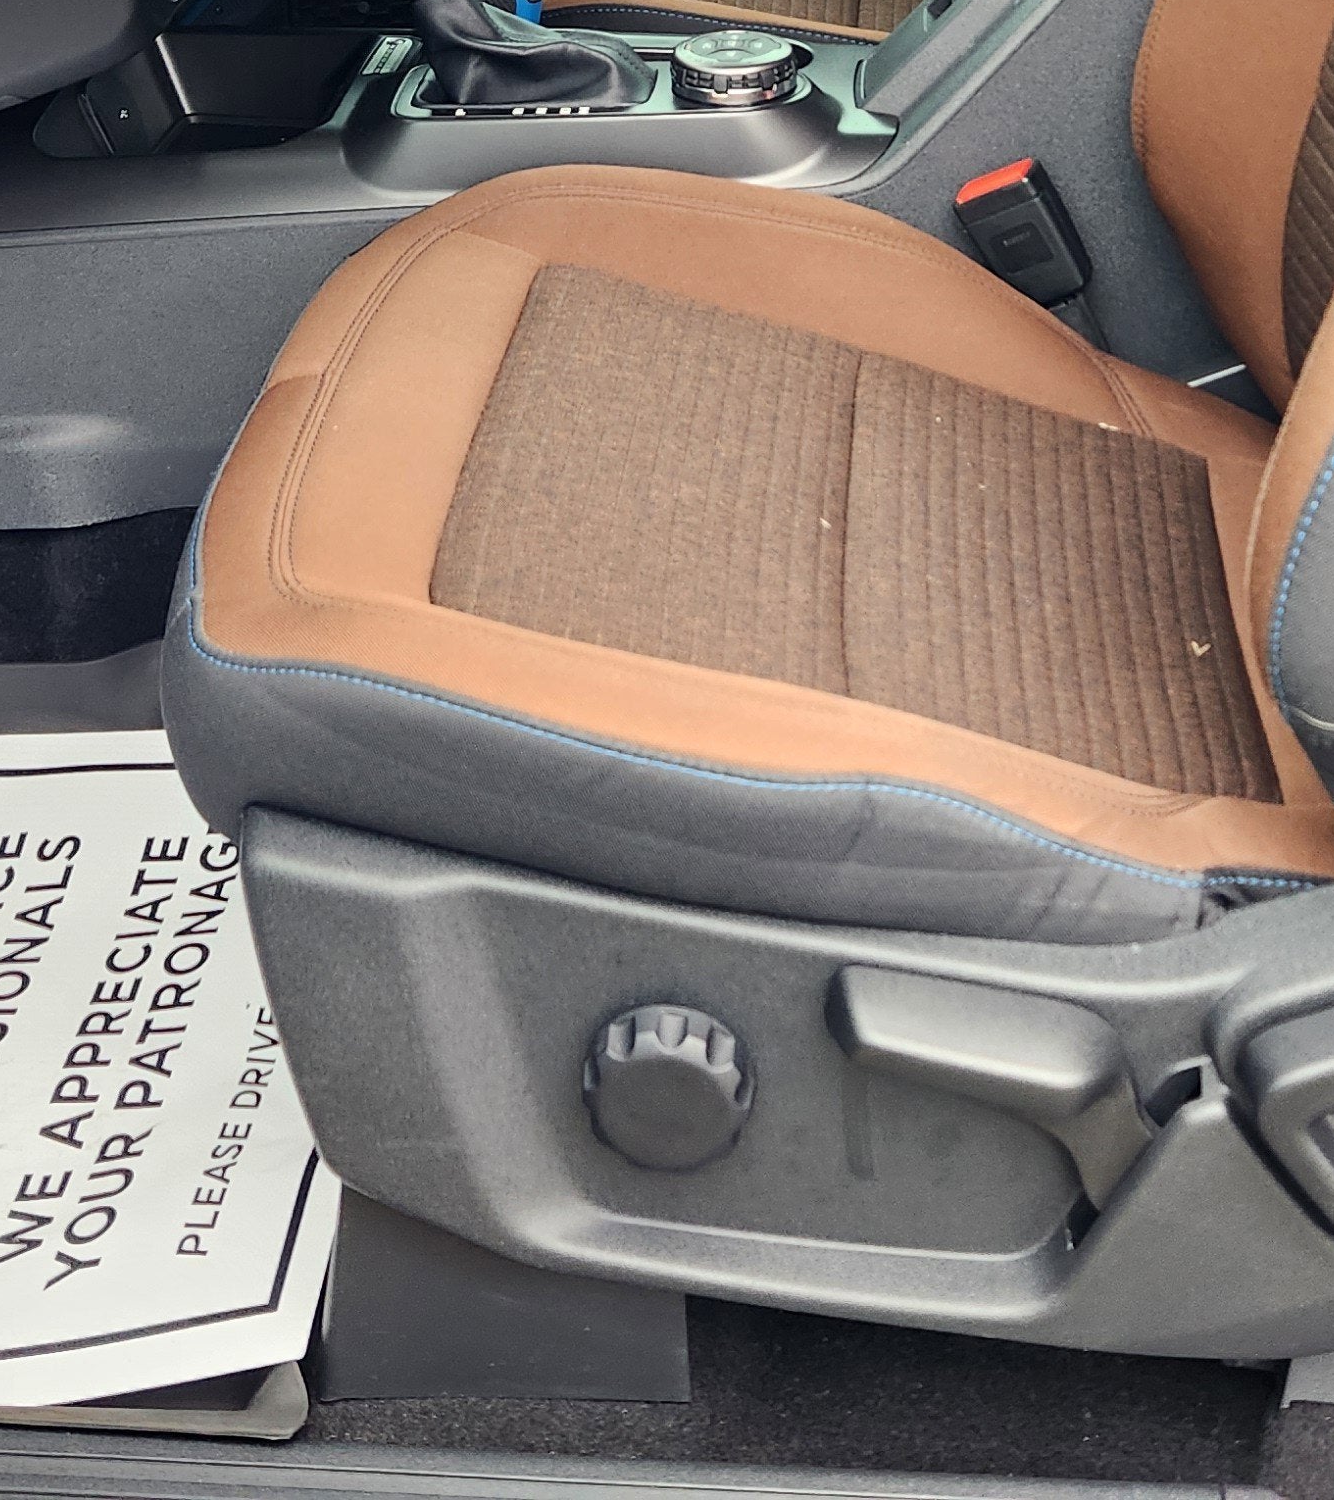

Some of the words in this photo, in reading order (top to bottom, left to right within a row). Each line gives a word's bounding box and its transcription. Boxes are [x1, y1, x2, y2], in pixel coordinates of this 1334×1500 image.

[38, 835, 189, 1149] APPRECIATE
[43, 1127, 153, 1291] YOUR
[113, 841, 240, 1111] PATRONAG
[176, 1121, 253, 1256] PLEASE
